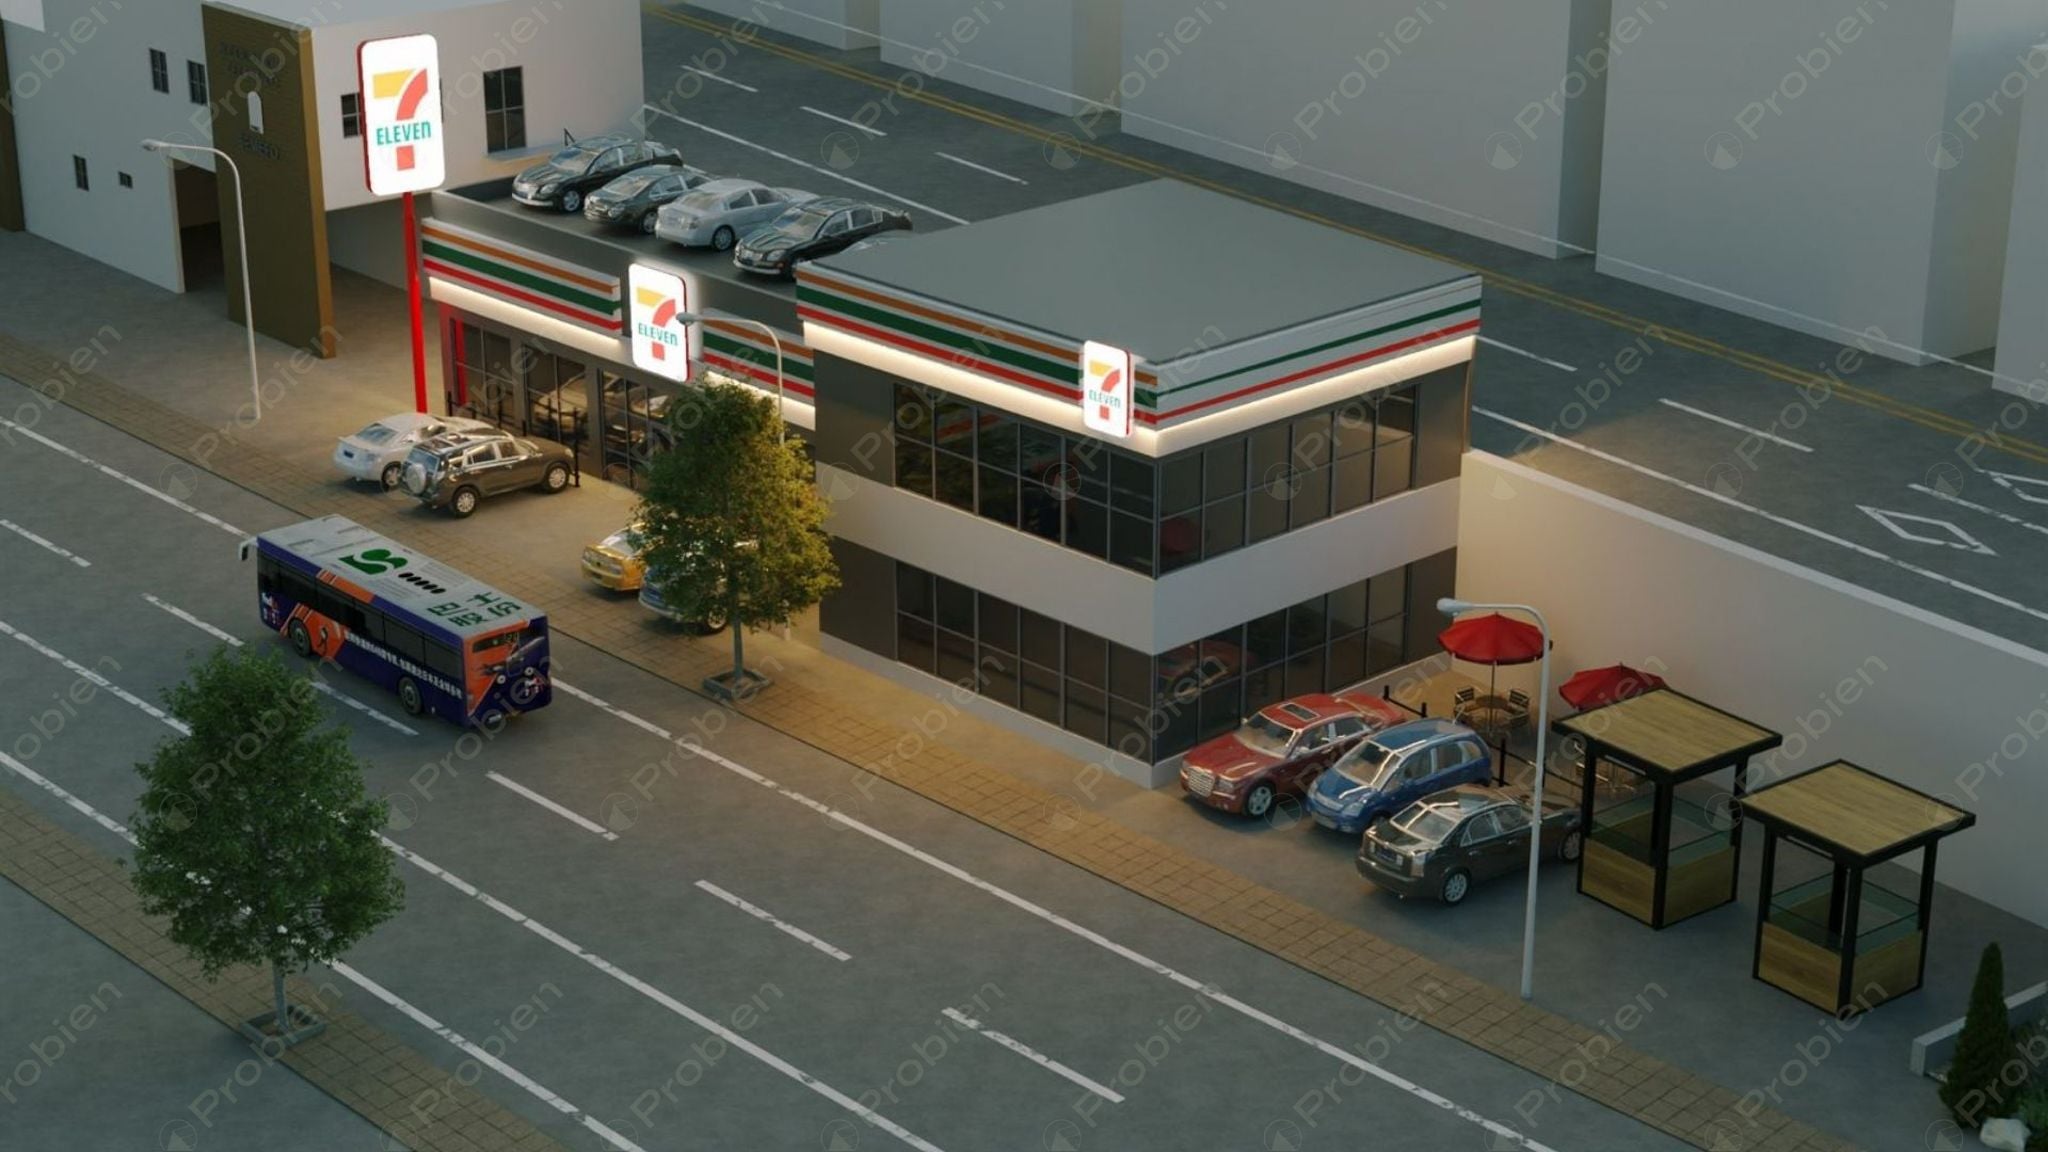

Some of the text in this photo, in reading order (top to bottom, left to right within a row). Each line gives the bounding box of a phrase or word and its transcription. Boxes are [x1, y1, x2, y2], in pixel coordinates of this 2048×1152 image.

[374, 68, 428, 171] 7
[637, 287, 677, 361] 7
[1089, 360, 1121, 420] 7
[427, 592, 501, 616] 巴士
